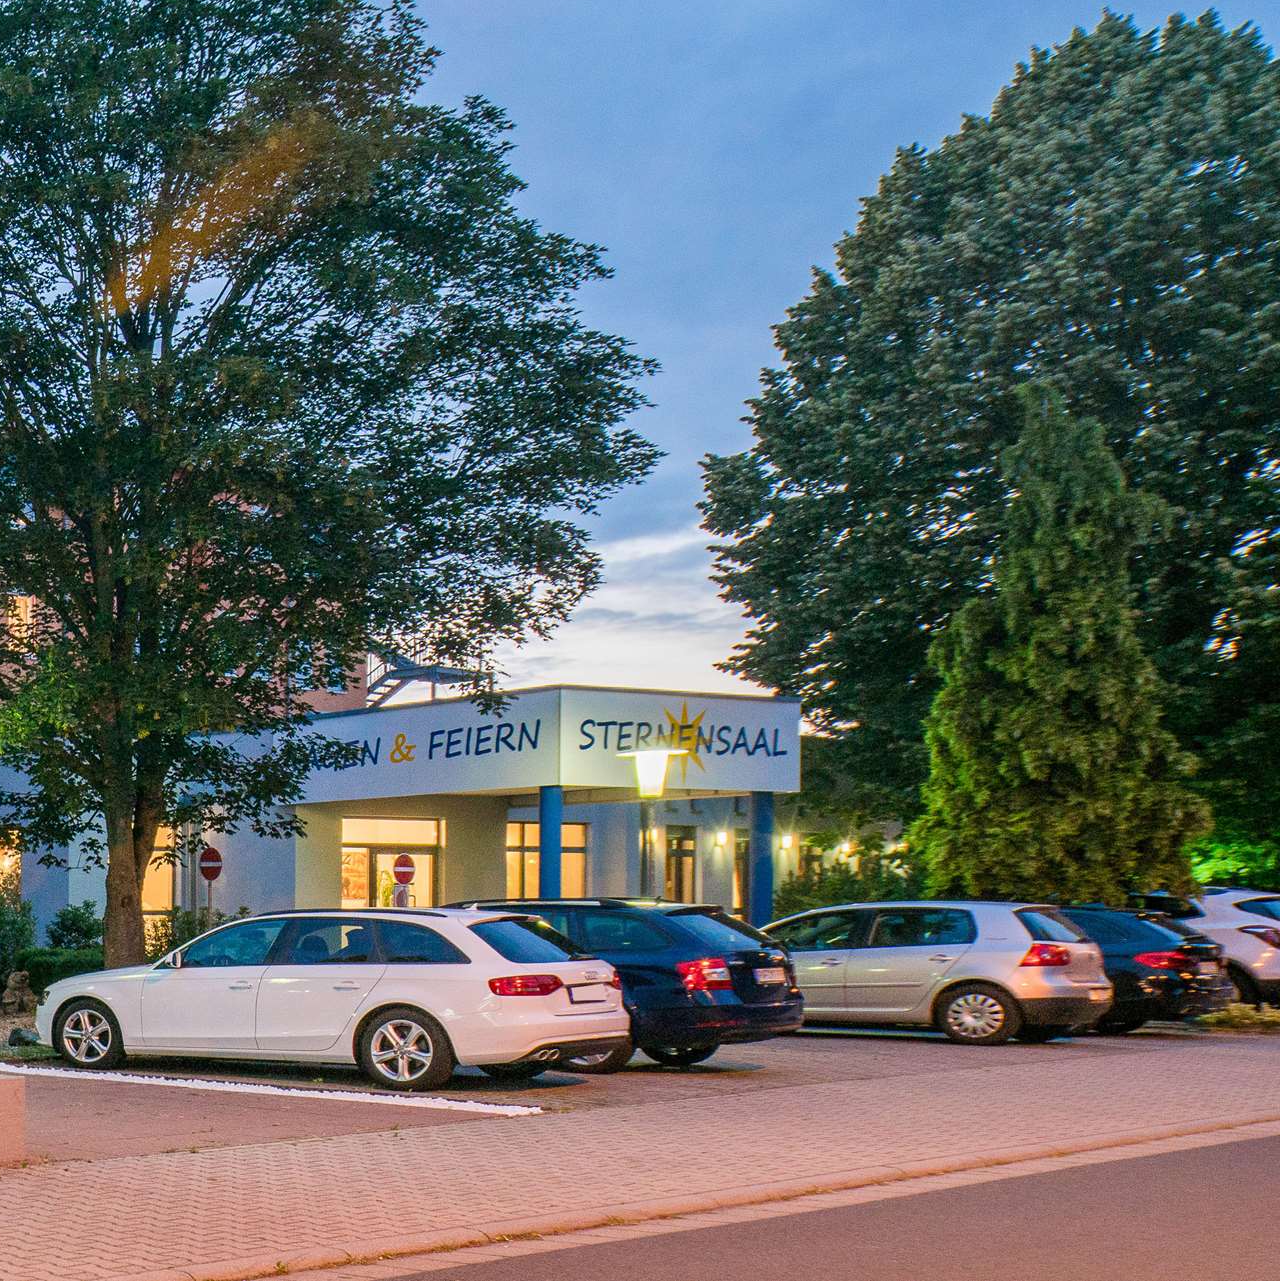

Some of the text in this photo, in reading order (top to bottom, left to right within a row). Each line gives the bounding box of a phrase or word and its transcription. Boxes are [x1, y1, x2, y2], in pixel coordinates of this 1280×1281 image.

[389, 733, 416, 763] &
[428, 718, 540, 760] FEIERN
[579, 718, 788, 757] STERNENSAAL
